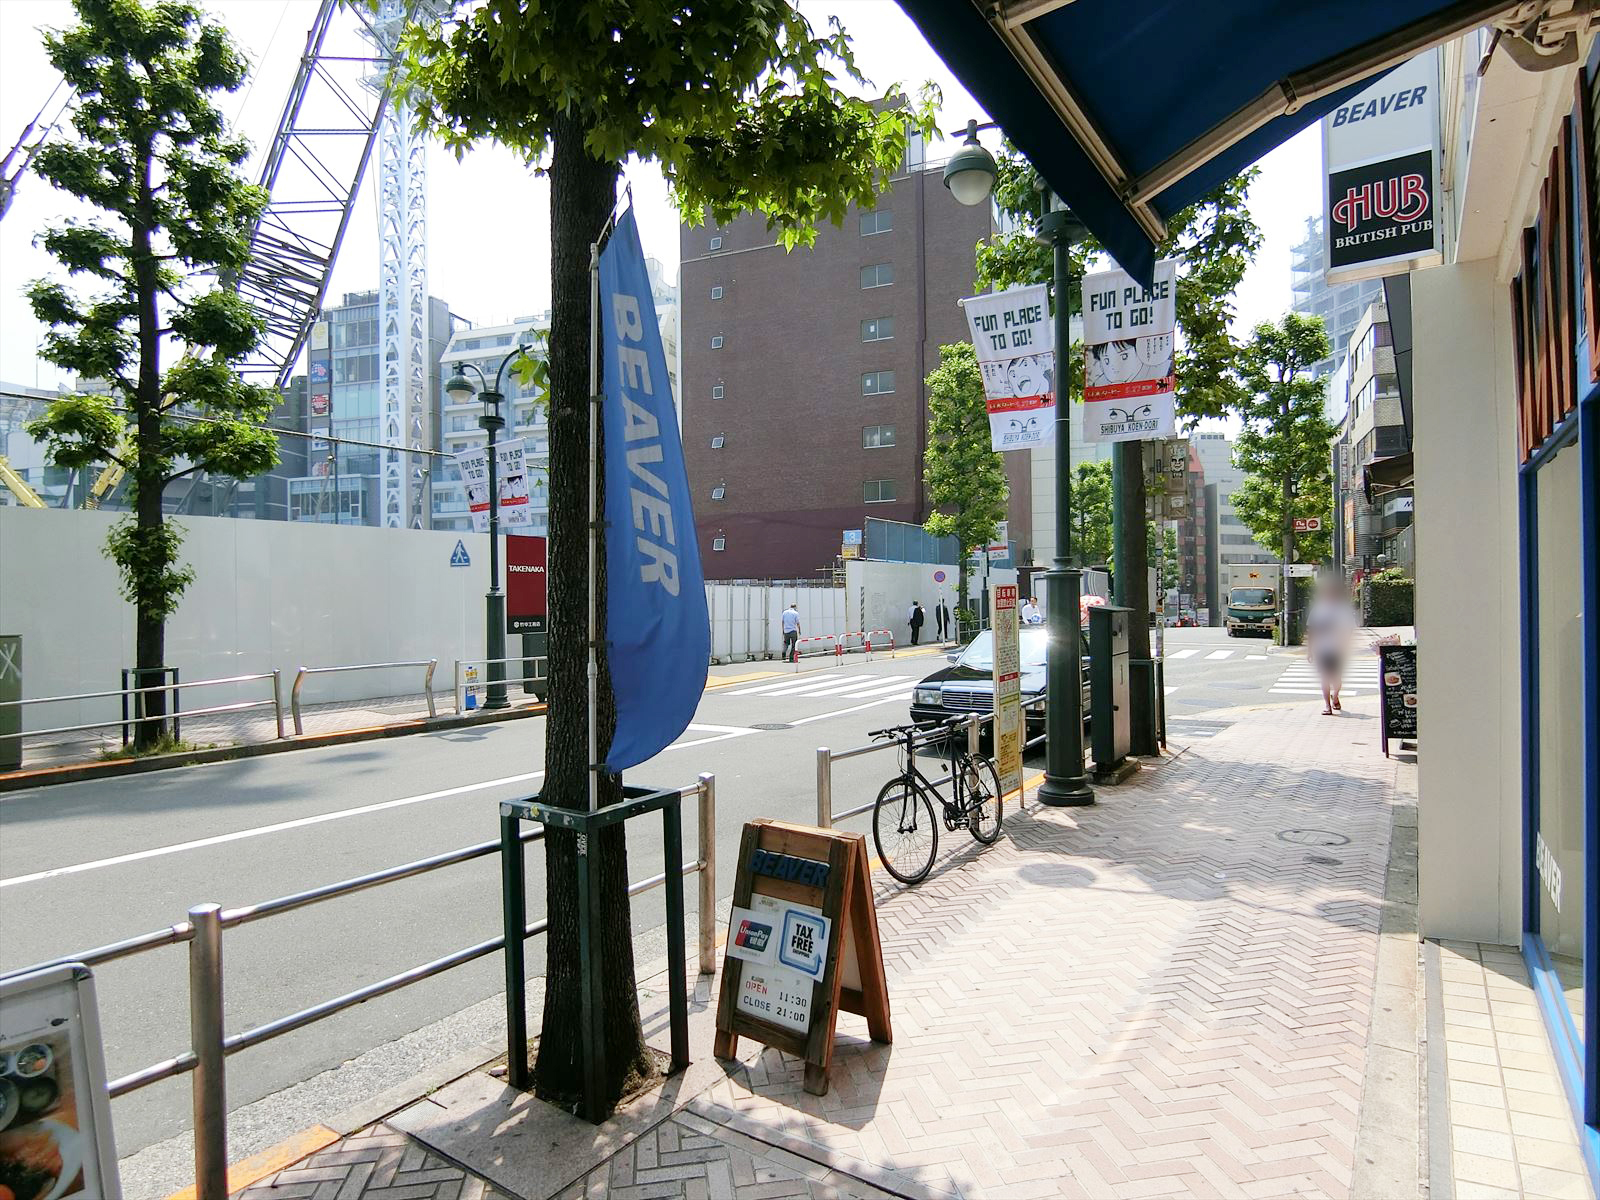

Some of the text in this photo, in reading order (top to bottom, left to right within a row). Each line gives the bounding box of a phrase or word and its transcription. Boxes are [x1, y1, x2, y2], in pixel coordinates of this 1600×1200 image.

[1332, 85, 1428, 128] BEAVER
[1332, 174, 1428, 233] HUB
[1335, 219, 1434, 249] BRITISH PUB
[1091, 290, 1117, 311] FUN
[973, 304, 1043, 334] FUN PLACE
[1106, 307, 1153, 330] TO GO!
[990, 328, 1034, 351] TO GO!
[1100, 418, 1159, 434] SHIBUYA KOEN-DORI
[612, 292, 681, 597] BEAVER
[751, 849, 830, 887] BEAVER
[740, 926, 768, 941] UnionPay
[791, 935, 814, 954] FREE
[795, 923, 814, 940] TAX
[745, 980, 808, 1008] OPEN 11:30
[743, 995, 805, 1022] CLOSE 21:00
